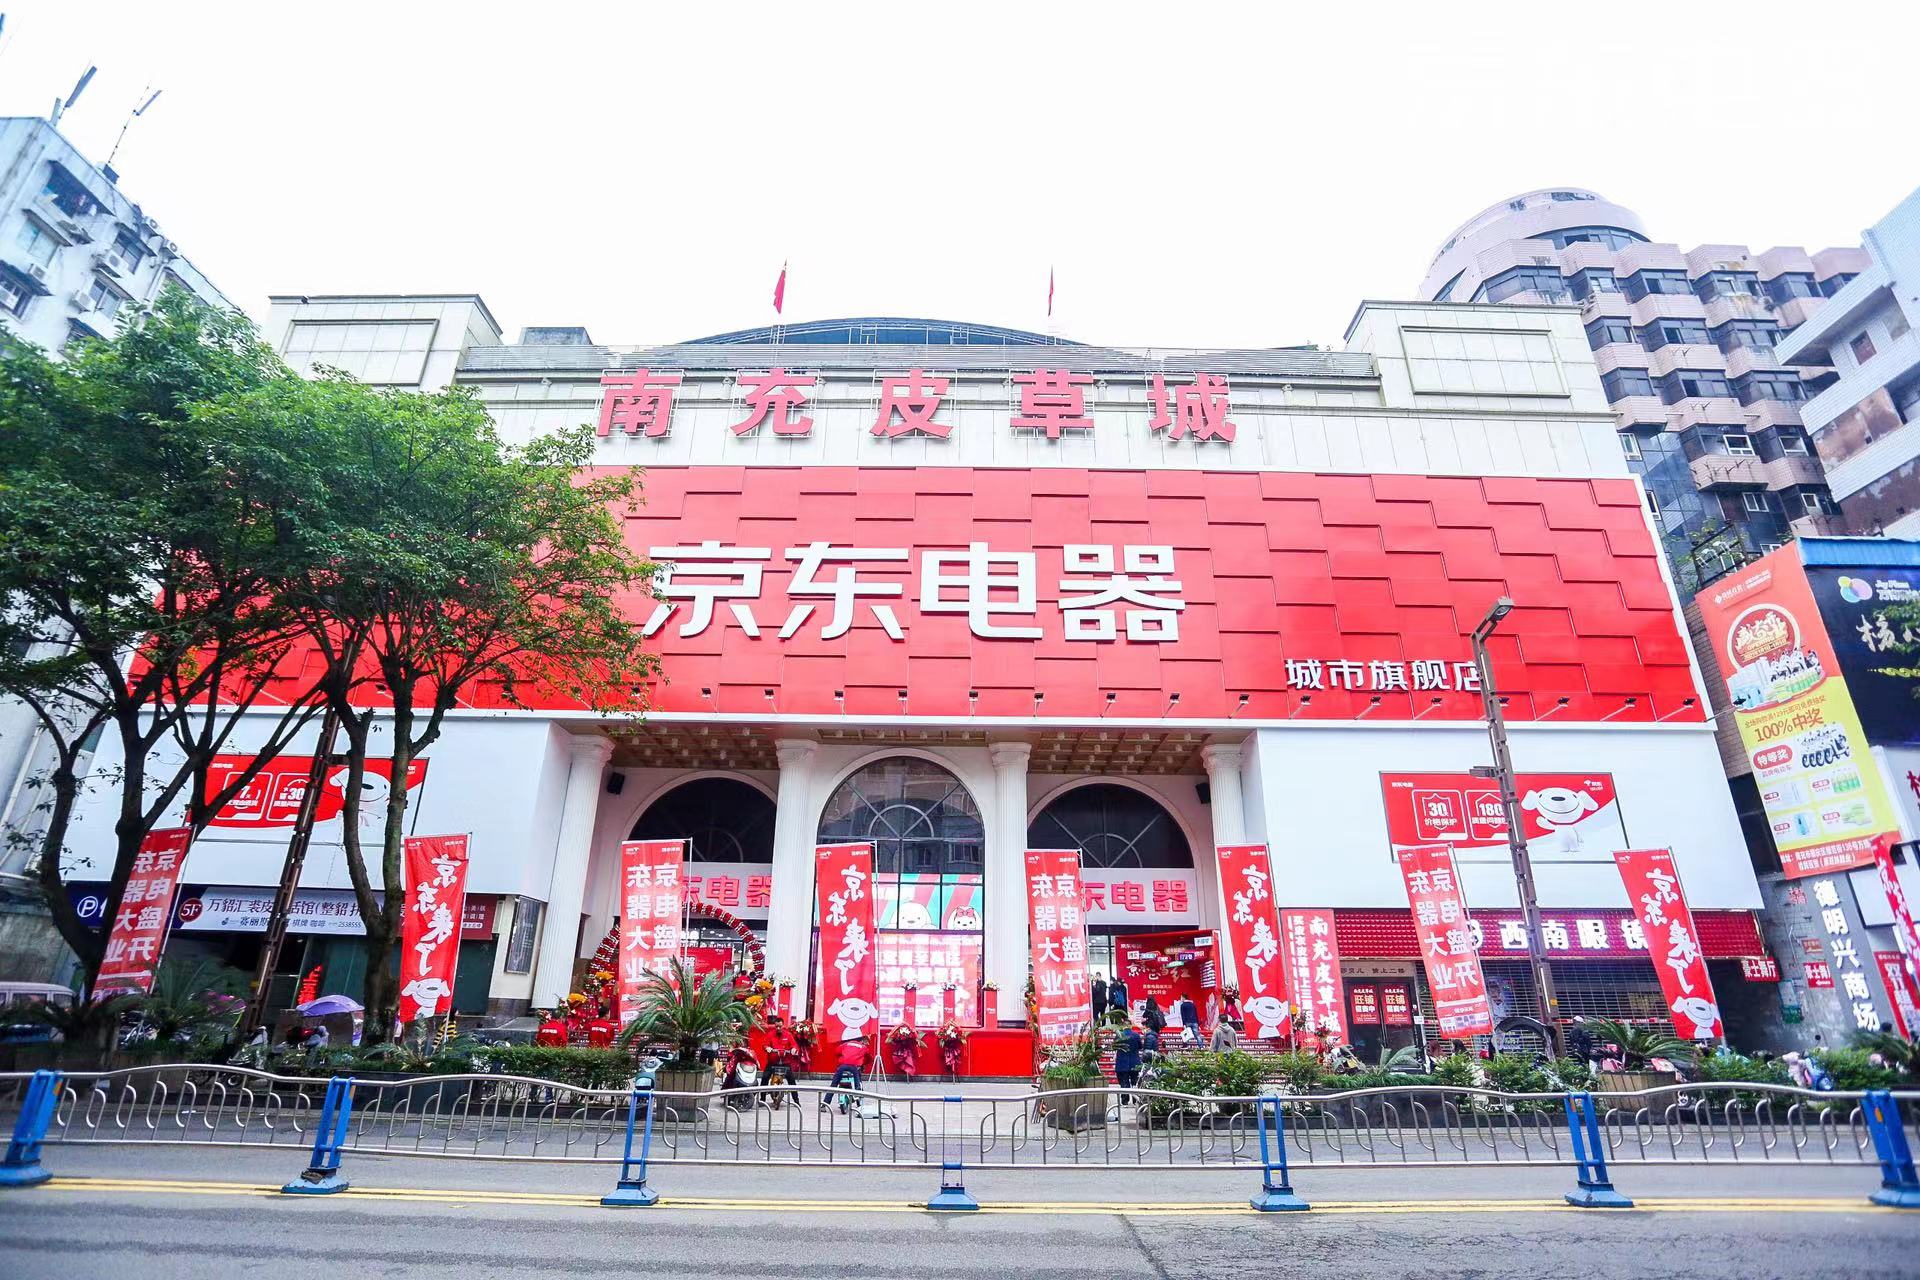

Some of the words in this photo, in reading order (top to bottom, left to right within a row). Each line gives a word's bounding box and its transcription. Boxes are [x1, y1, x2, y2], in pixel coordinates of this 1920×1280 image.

[595, 368, 1237, 443] 南充皮草城
[641, 540, 1185, 641] 京东电器
[1284, 658, 1482, 691] 城市旗舰店
[1754, 707, 1825, 743] 100%中奖
[181, 903, 201, 917] 5F
[1308, 914, 1342, 1033] 南充皮草城
[1813, 879, 1881, 1032] 德明兴商场
[1354, 994, 1375, 1005] 旺铺
[1385, 994, 1406, 1005] 旺铺
